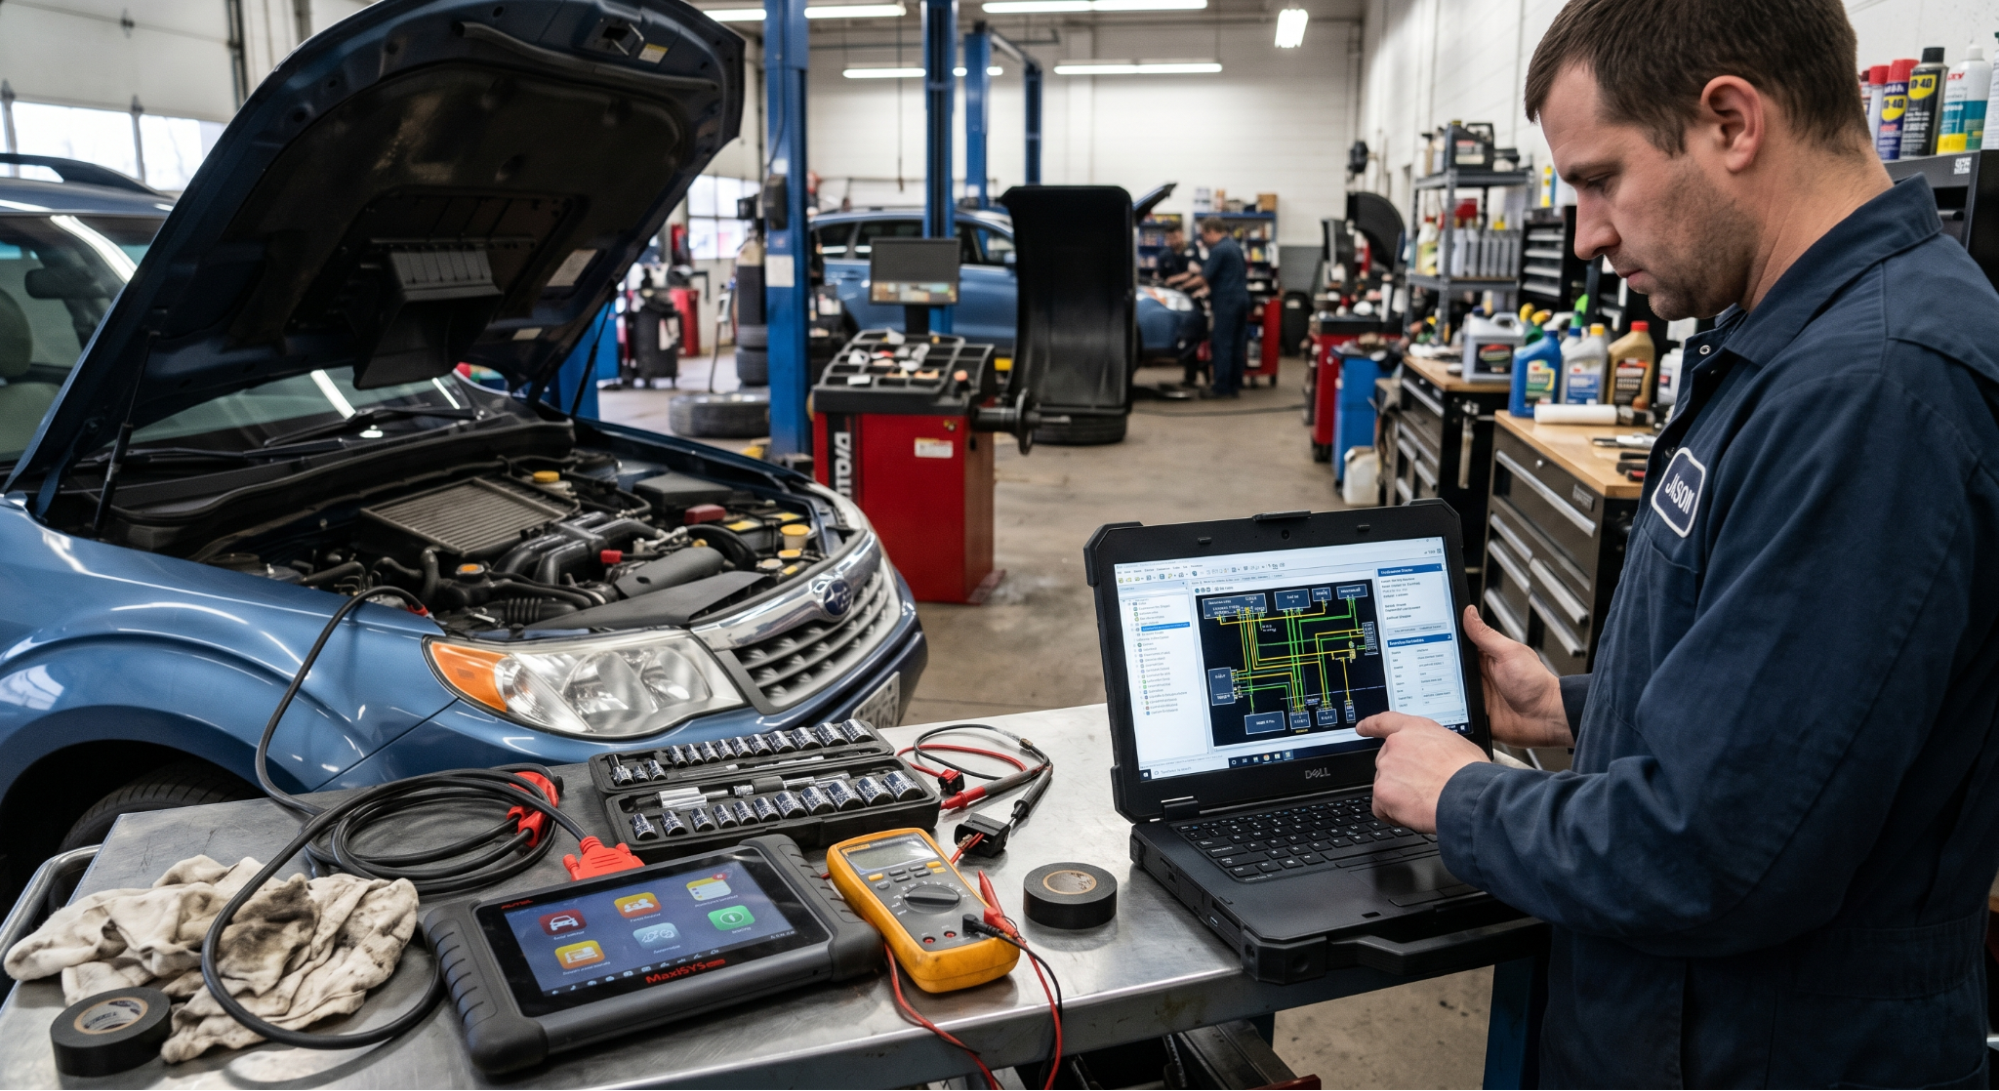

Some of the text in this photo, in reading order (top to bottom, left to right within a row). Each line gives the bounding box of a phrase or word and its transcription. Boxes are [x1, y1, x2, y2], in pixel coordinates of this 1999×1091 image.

[1910, 77, 1933, 89] D-40
[1664, 472, 1696, 515] JASON
[1304, 767, 1332, 780] DELL
